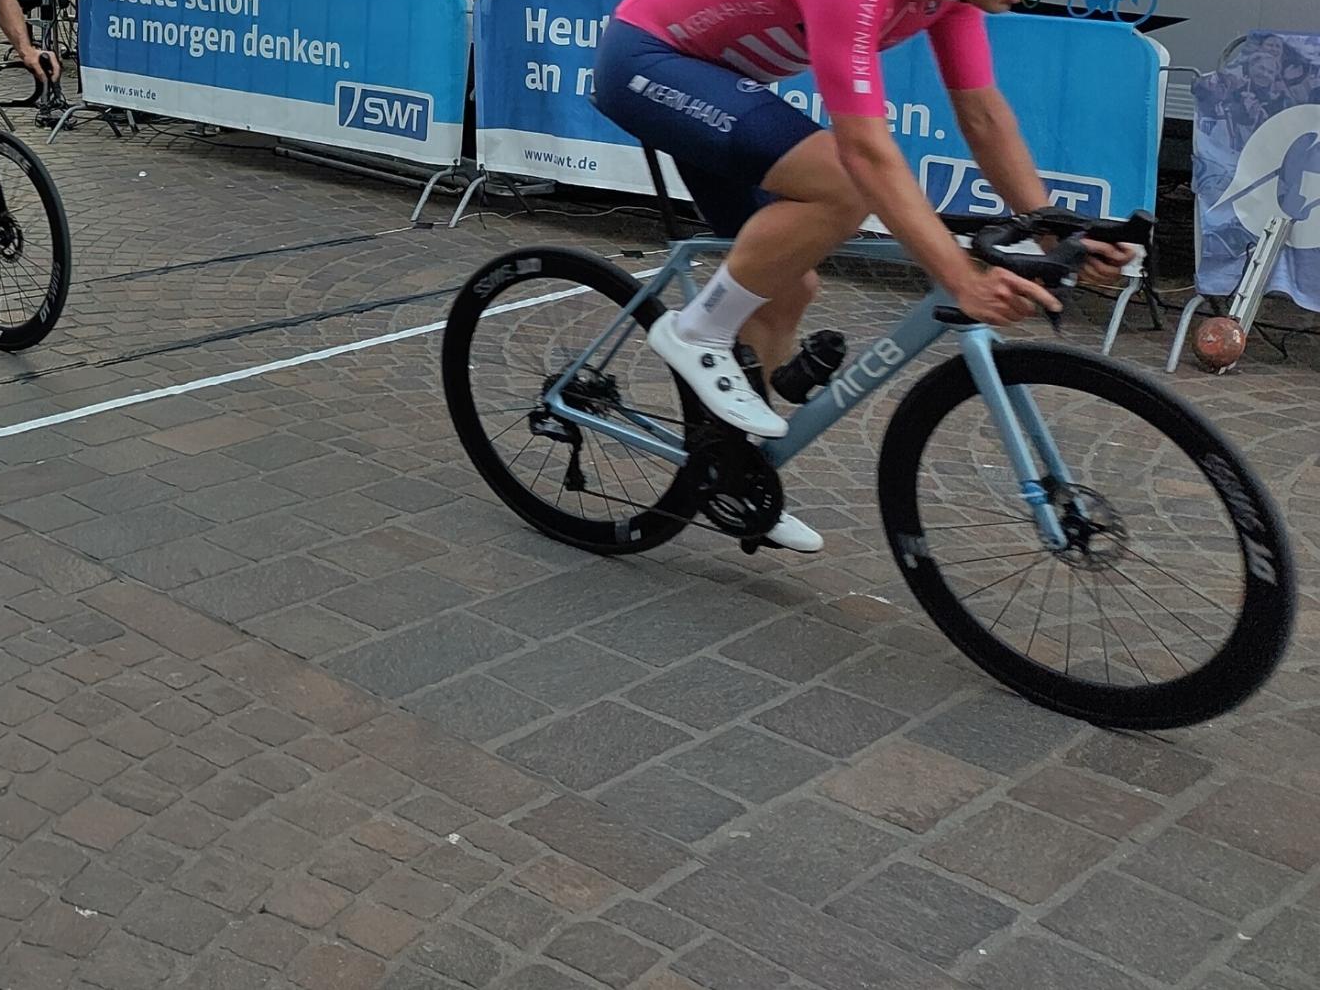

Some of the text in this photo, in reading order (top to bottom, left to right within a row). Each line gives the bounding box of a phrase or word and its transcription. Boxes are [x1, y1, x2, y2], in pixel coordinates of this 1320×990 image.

[107, 13, 351, 70] an morgen denken.
[104, 82, 158, 102] www.swt.de
[525, 60, 561, 93] an
[363, 97, 424, 133] SWT
